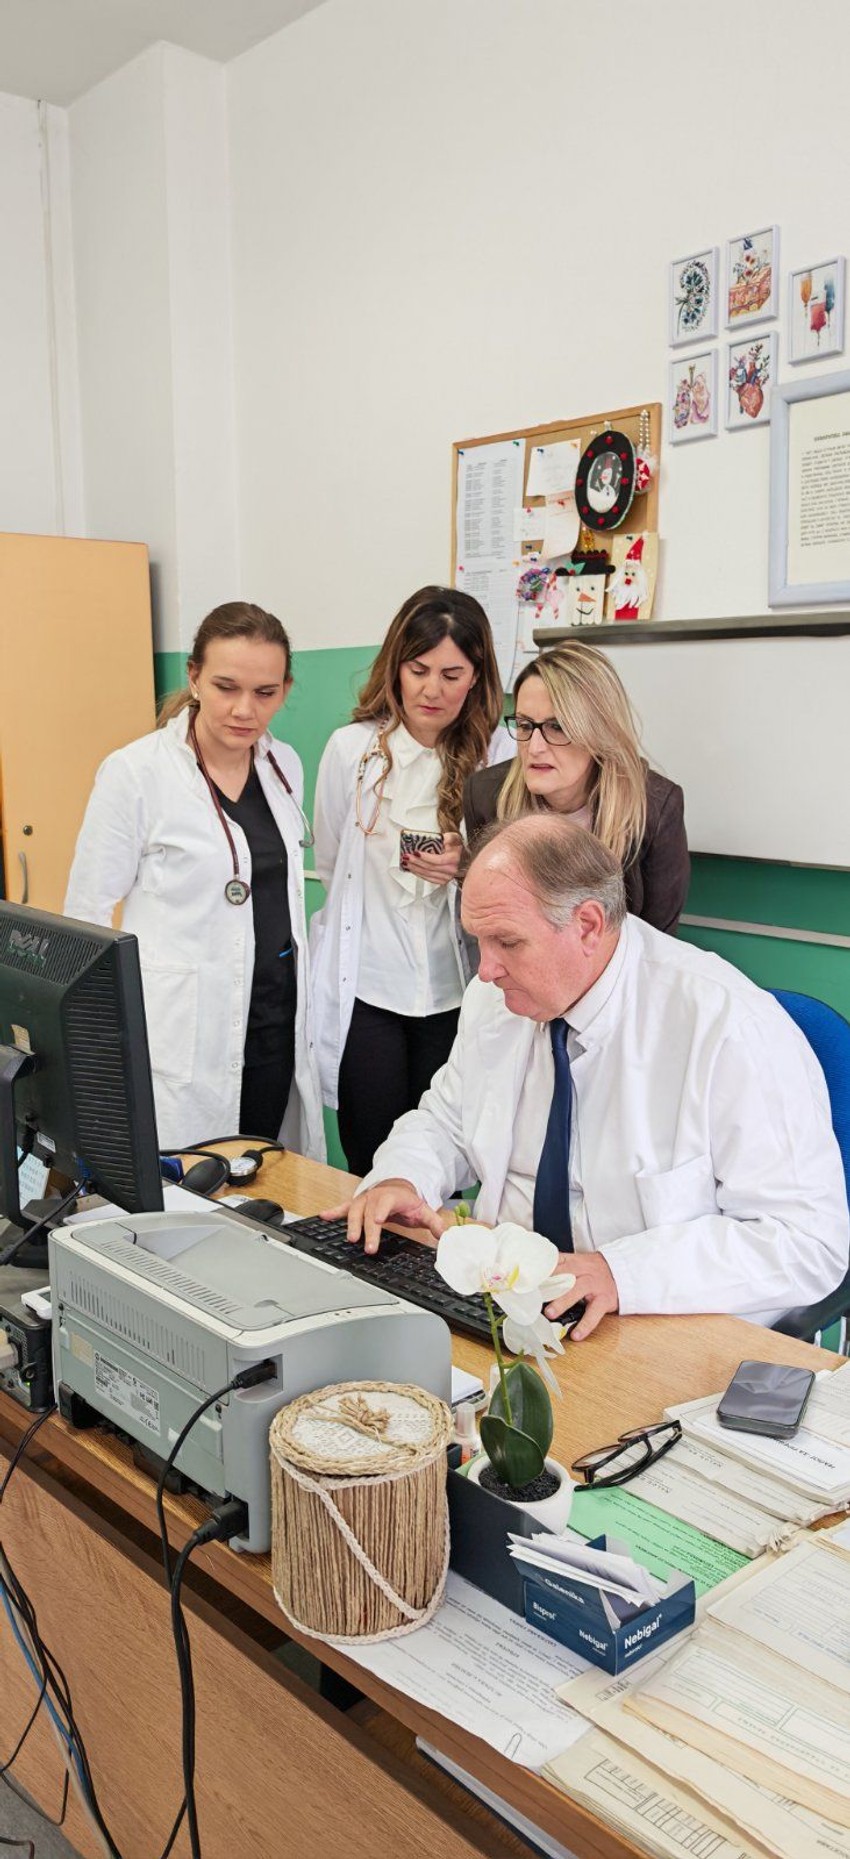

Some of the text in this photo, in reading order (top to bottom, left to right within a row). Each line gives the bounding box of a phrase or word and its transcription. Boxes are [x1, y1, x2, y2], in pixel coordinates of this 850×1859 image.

[9, 929, 50, 958] DELL
[545, 1578, 585, 1604] Galenika
[579, 1629, 607, 1651] Nebigal
[624, 1616, 660, 1649] Nebigal
